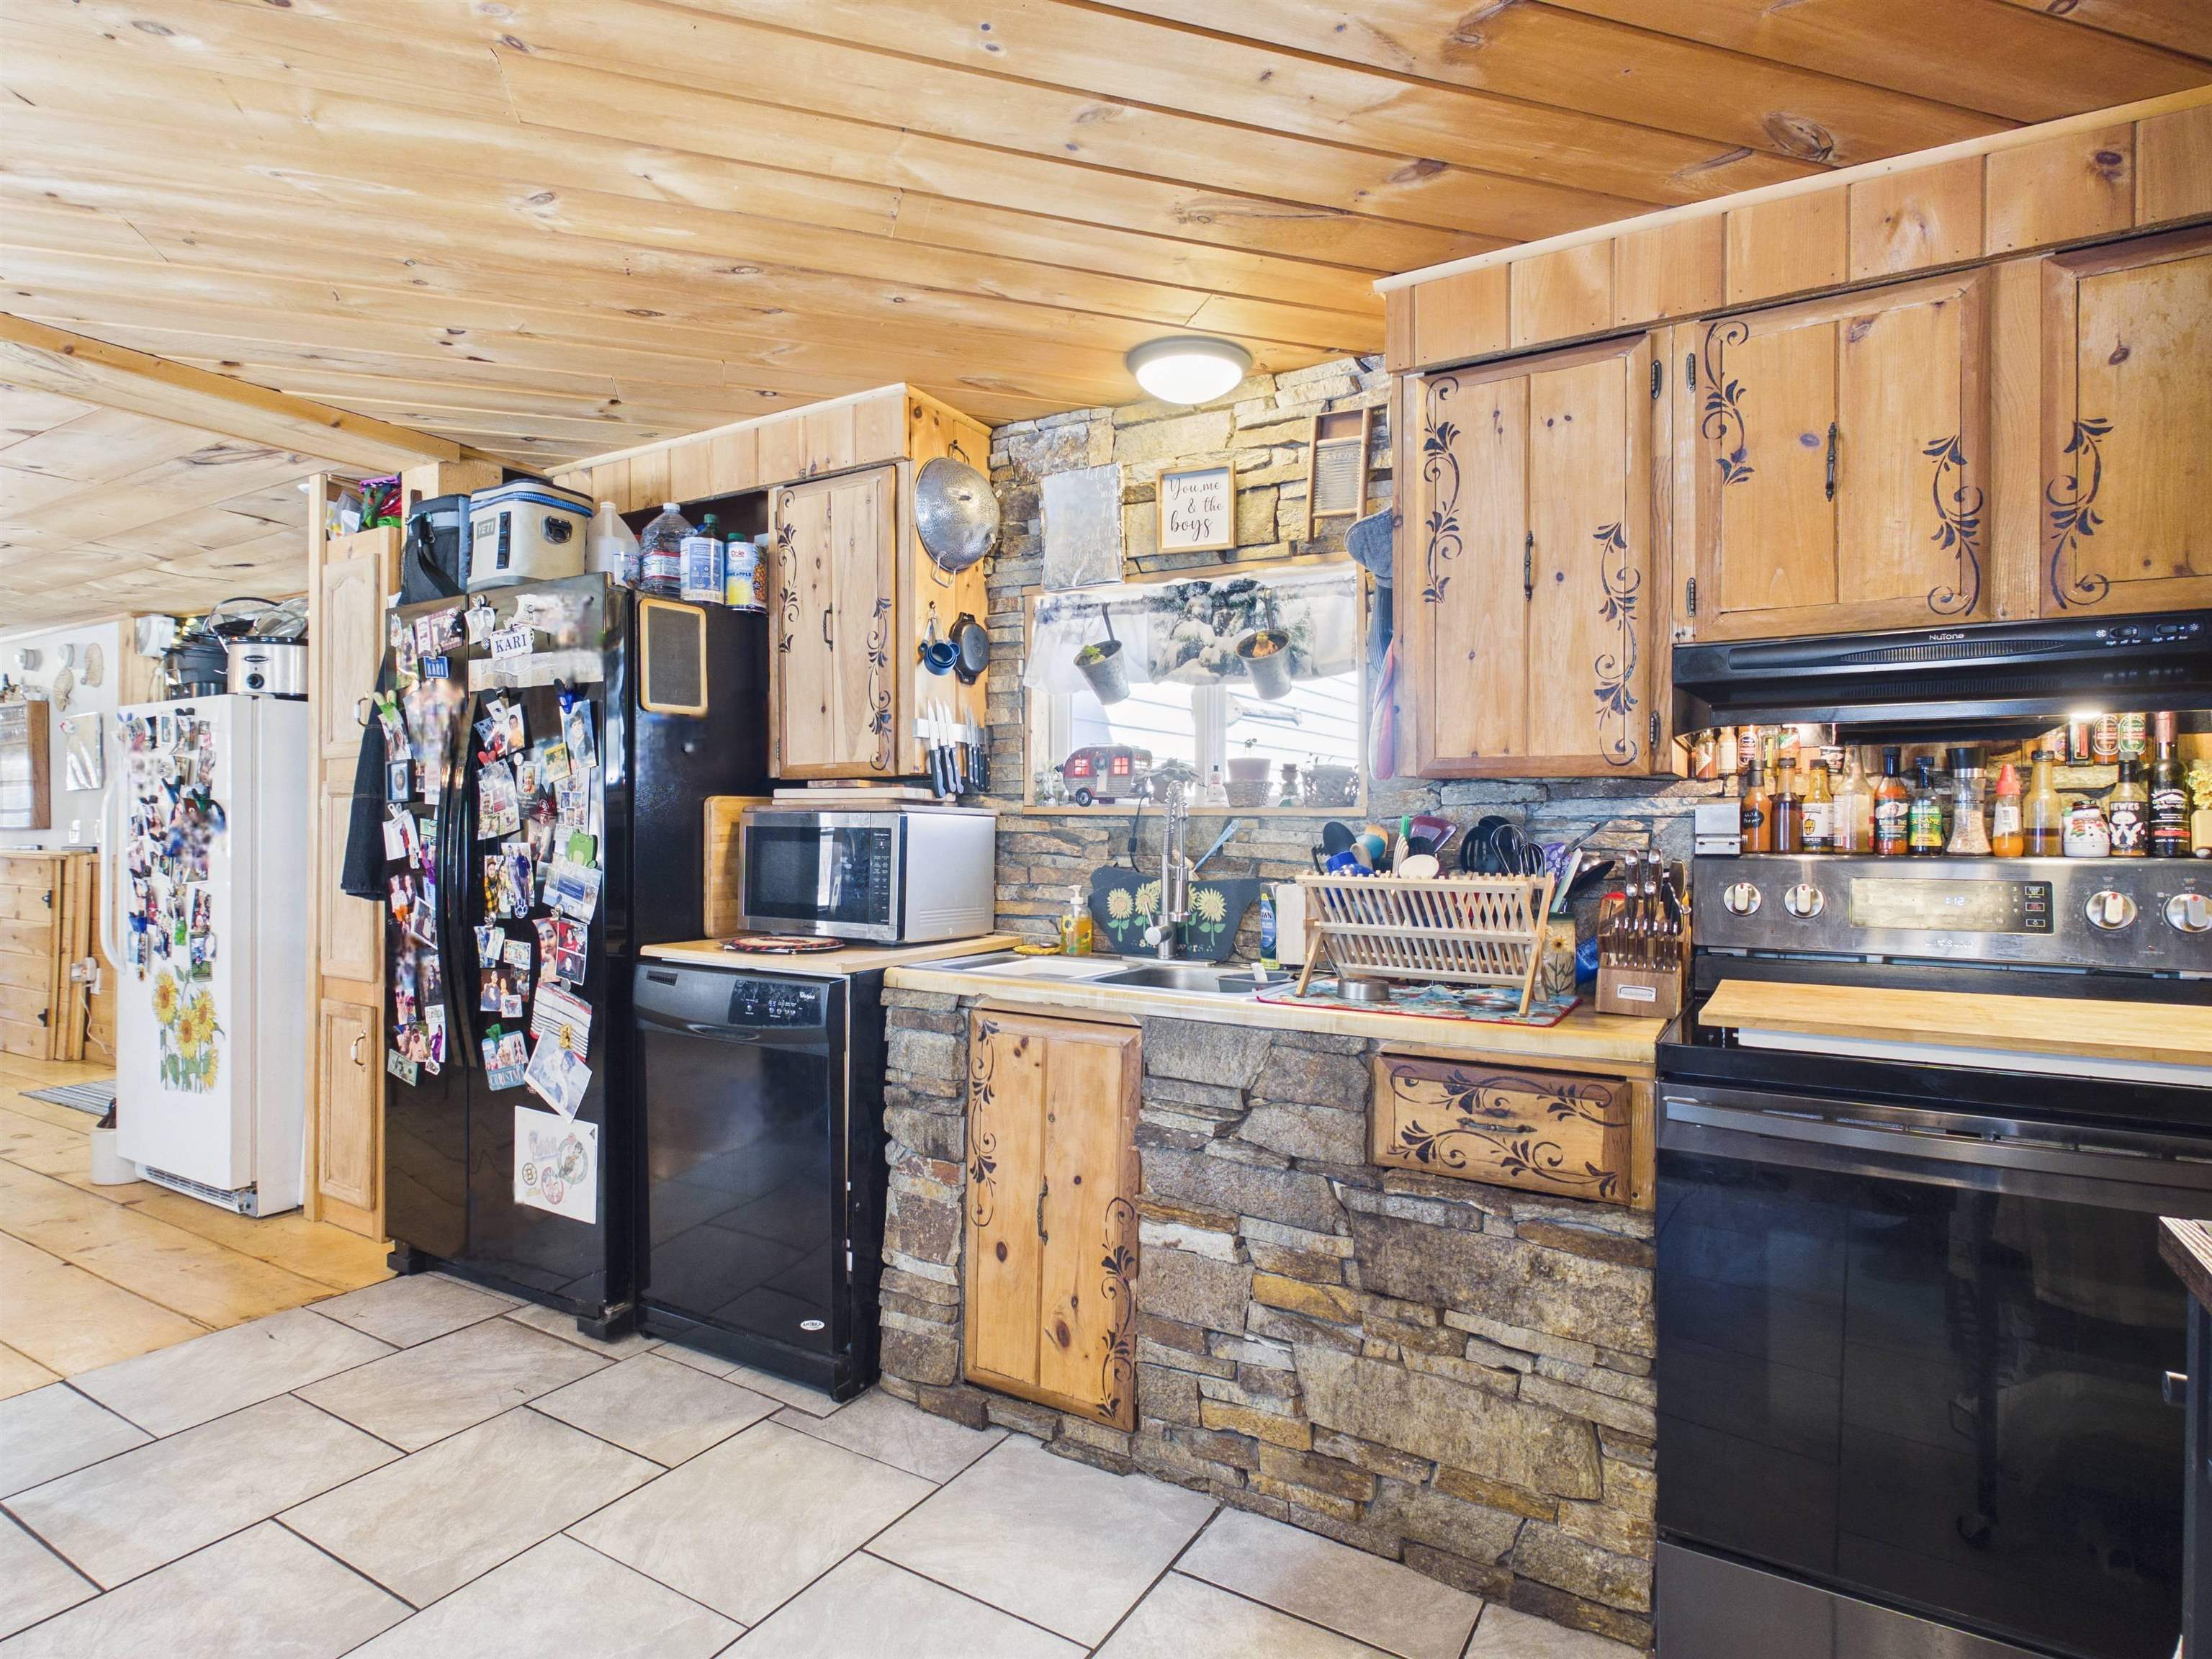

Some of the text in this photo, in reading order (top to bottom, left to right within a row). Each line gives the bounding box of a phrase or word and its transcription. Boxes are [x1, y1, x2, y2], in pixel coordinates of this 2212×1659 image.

[1187, 495, 1223, 514] & the
[478, 521, 494, 536] YETI
[1170, 510, 1213, 542] boys
[495, 634, 526, 653] KARI
[1262, 911, 1272, 920] AWN
